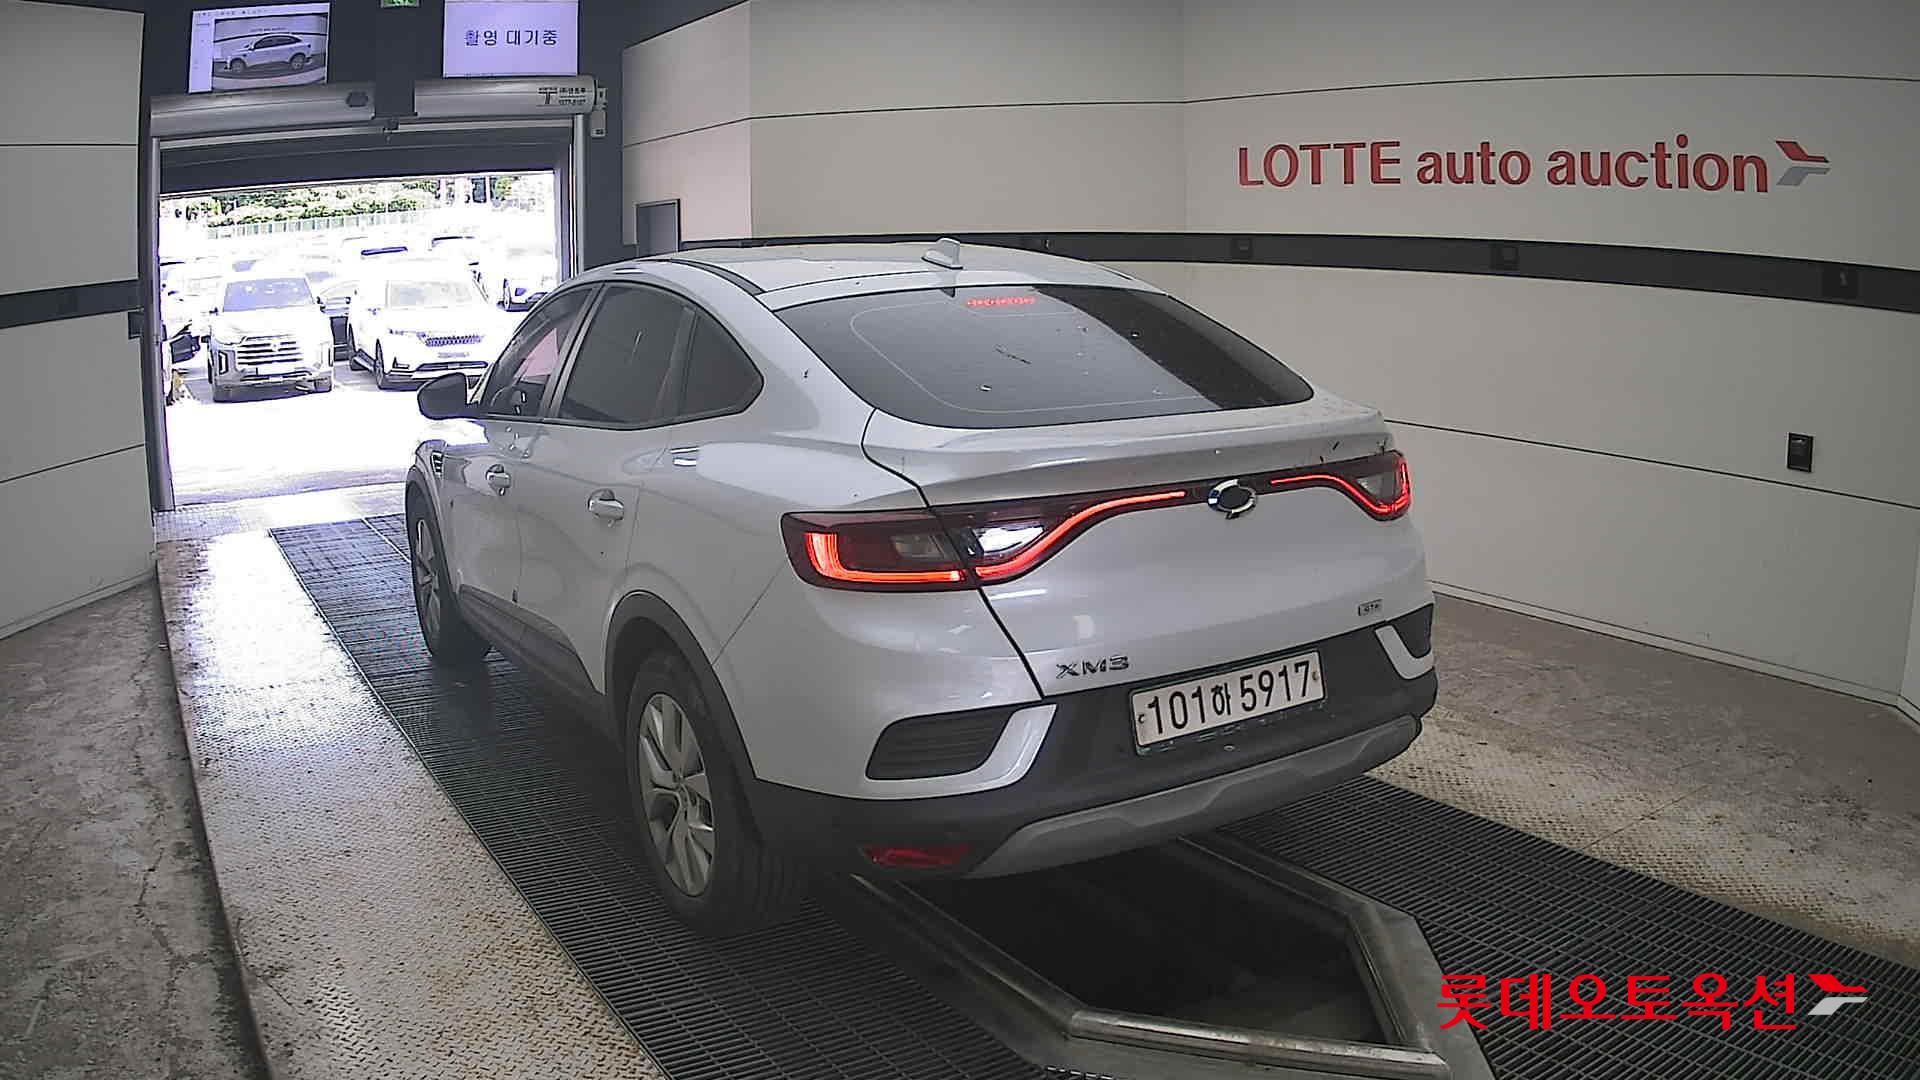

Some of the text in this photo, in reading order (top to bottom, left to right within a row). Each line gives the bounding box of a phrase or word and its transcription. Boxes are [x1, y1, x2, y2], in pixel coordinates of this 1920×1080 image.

[506, 28, 558, 46] 대기중
[1238, 134, 1769, 194] LOTTE auto auction
[1056, 654, 1130, 679] XM3
[1240, 660, 1310, 713] 5917
